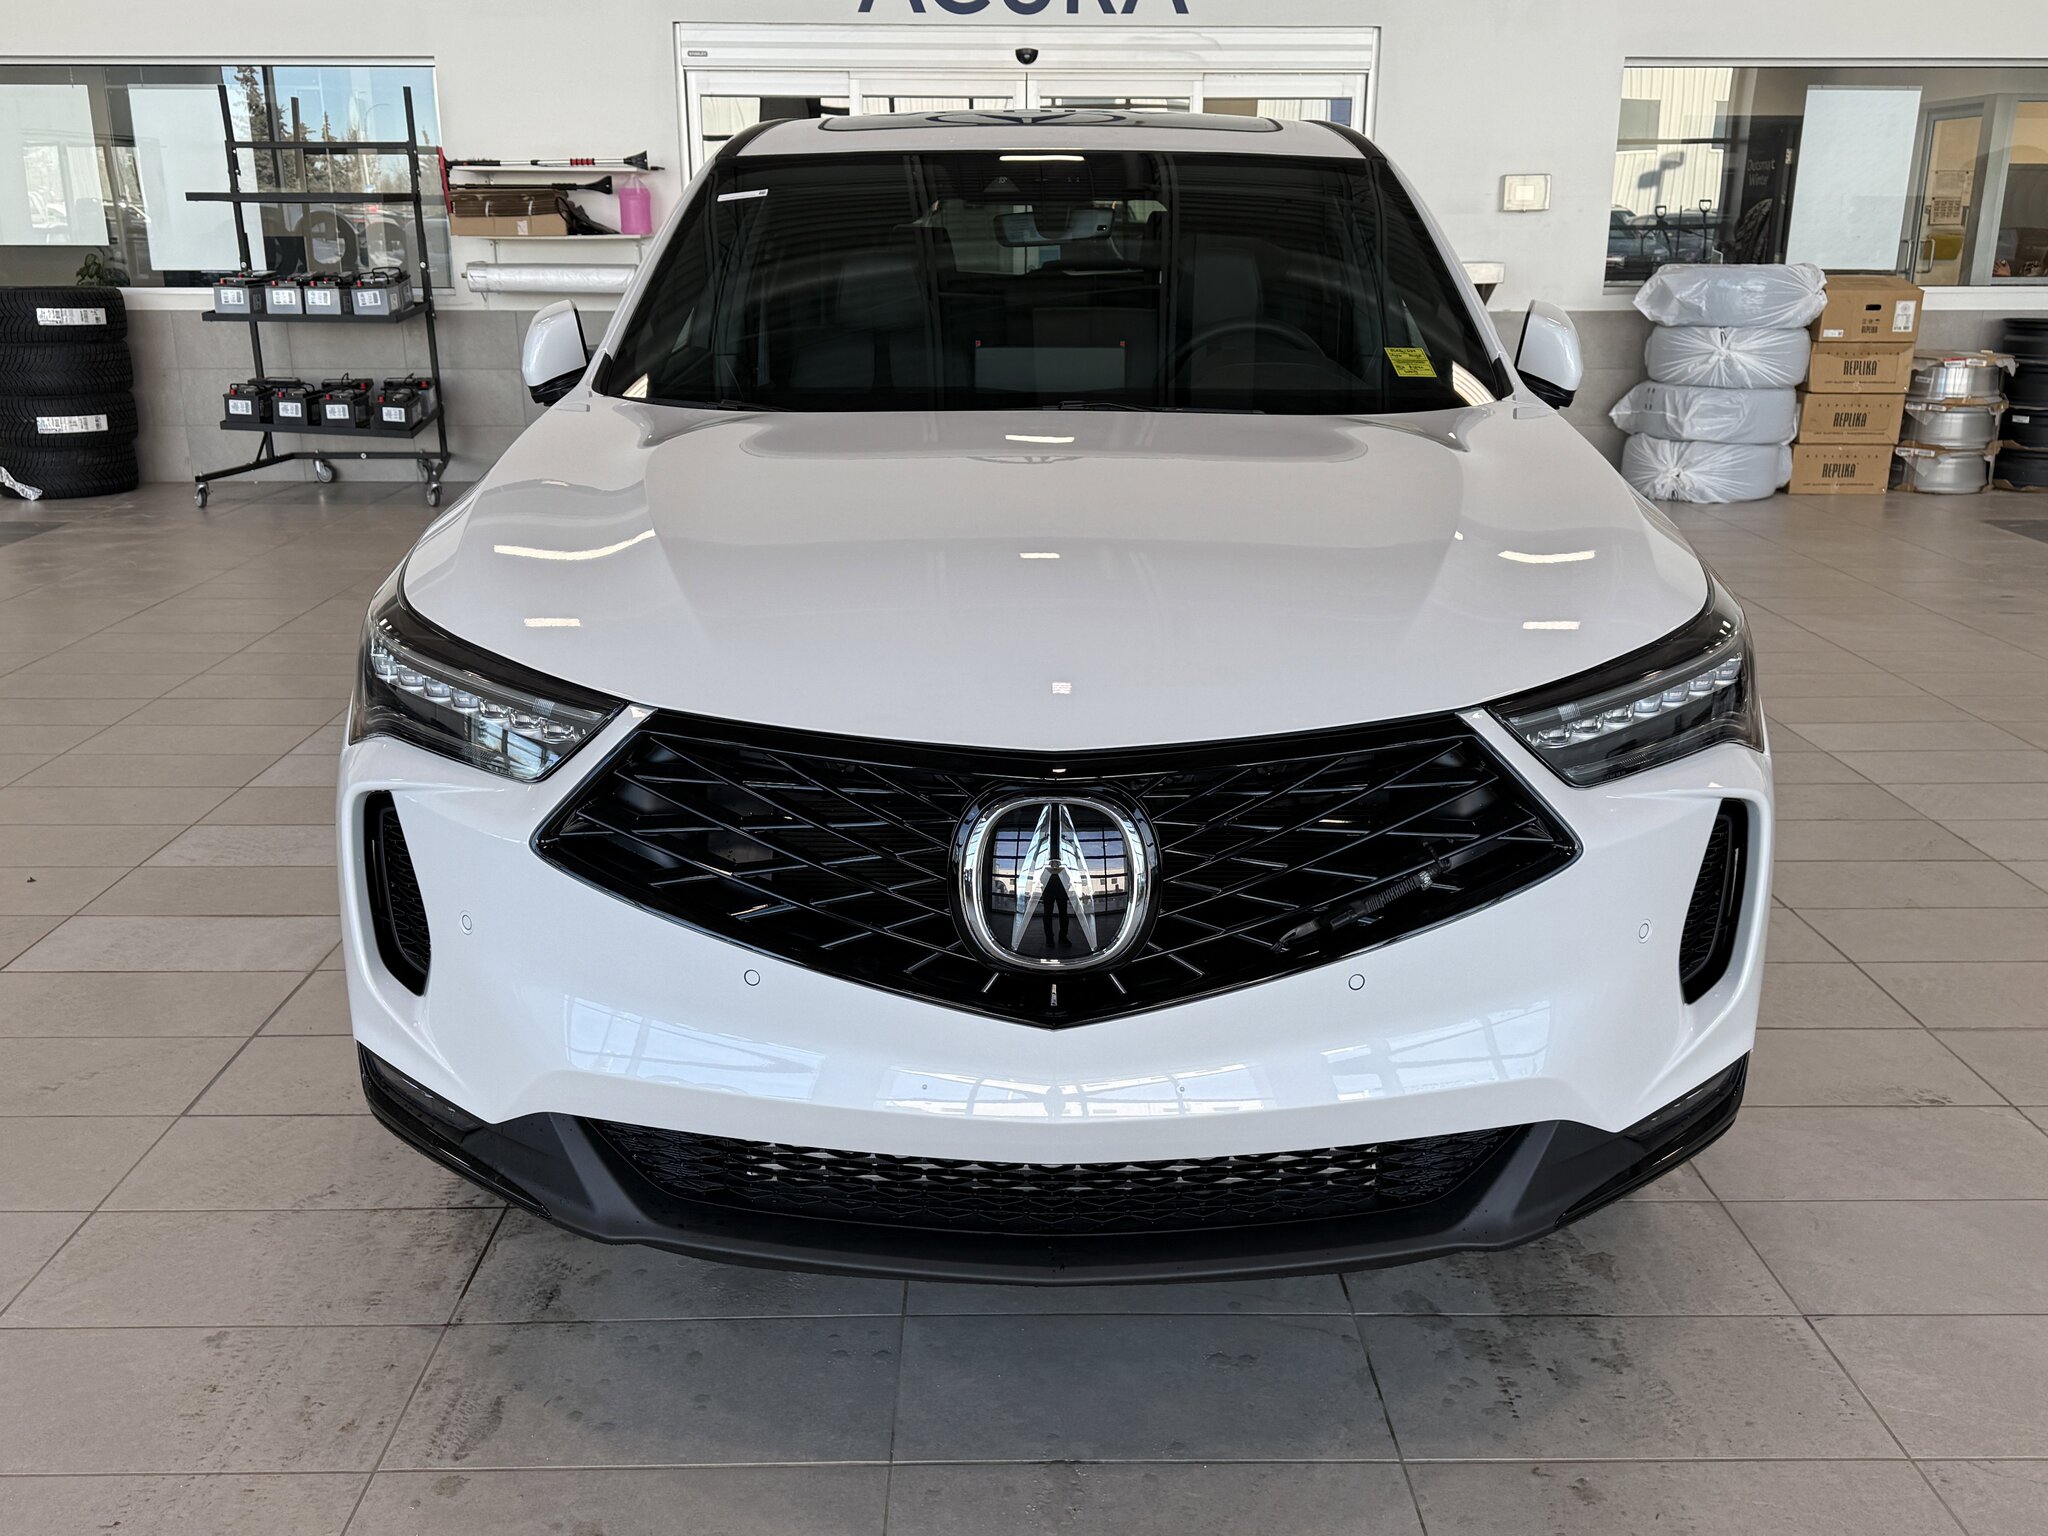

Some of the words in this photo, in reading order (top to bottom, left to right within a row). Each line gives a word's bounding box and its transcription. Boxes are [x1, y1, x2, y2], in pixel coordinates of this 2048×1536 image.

[1747, 159, 1776, 171] Outsmat
[1843, 360, 1878, 376] REPLIKA
[1833, 412, 1868, 427] REPLIKA
[1821, 463, 1856, 478] REPLIKA
